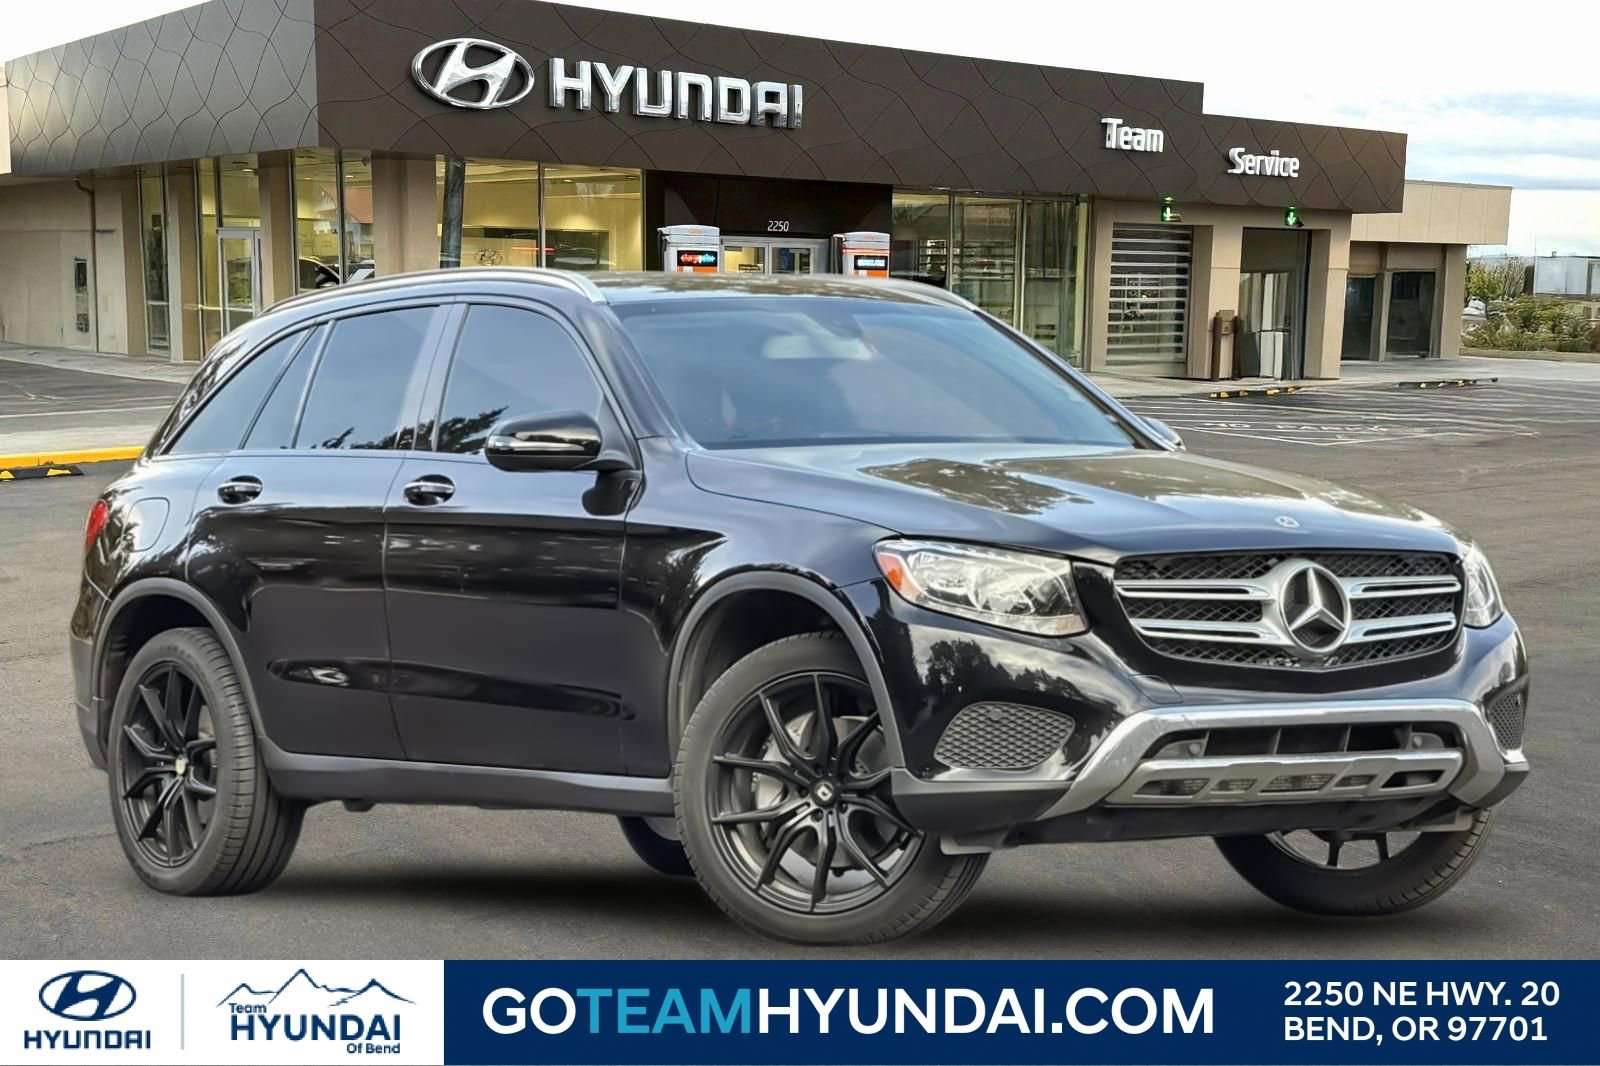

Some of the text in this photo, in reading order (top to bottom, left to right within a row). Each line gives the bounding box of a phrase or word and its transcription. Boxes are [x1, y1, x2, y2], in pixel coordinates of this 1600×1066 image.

[548, 57, 803, 129] HYUNDAI
[1101, 117, 1165, 153] Team
[1227, 147, 1300, 178] Service
[767, 220, 790, 232] 2250
